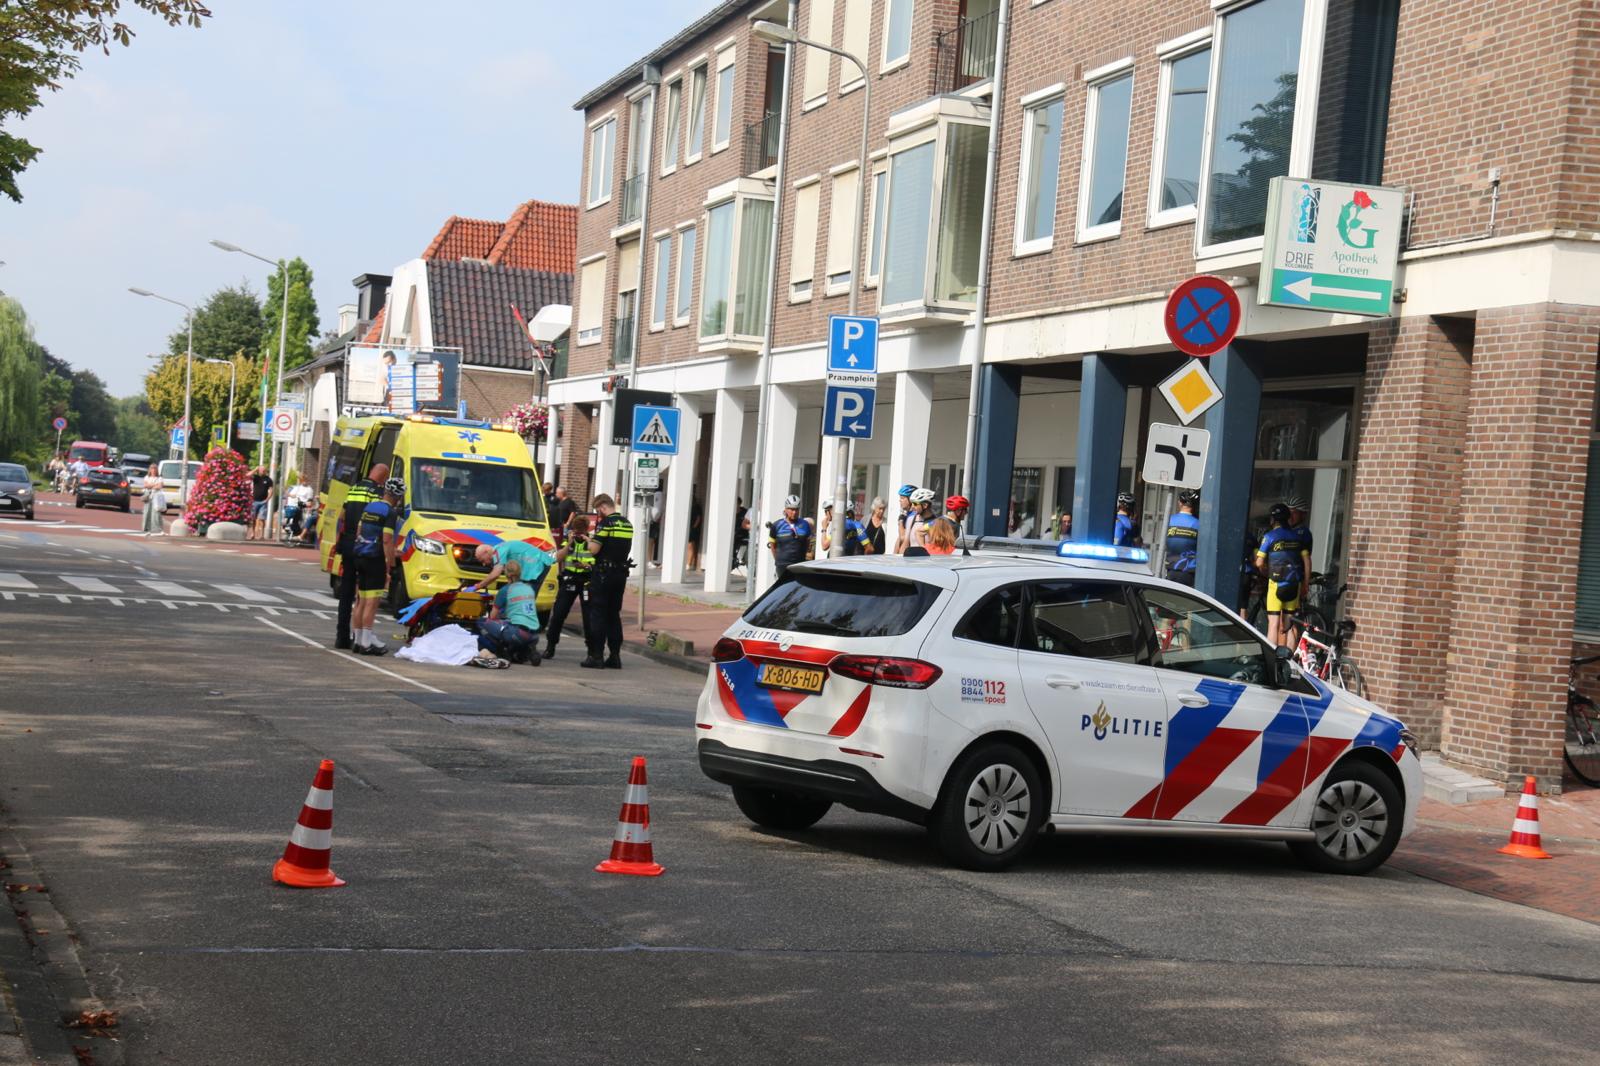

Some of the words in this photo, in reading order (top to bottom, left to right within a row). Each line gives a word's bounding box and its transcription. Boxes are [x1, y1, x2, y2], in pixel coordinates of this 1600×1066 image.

[1285, 250, 1315, 266] DRIE
[1331, 250, 1379, 265] Apotheek
[1338, 264, 1369, 276] Groen
[843, 320, 864, 350] P
[828, 373, 875, 383] Praamplein
[833, 390, 865, 432] P
[738, 629, 782, 641] POLITIE
[764, 666, 820, 689] X-806-HD
[961, 677, 983, 688] 0900
[961, 687, 984, 696] 8844
[984, 680, 1006, 695] 112
[984, 696, 1006, 704] spoed
[1081, 714, 1163, 741] POLITIE
